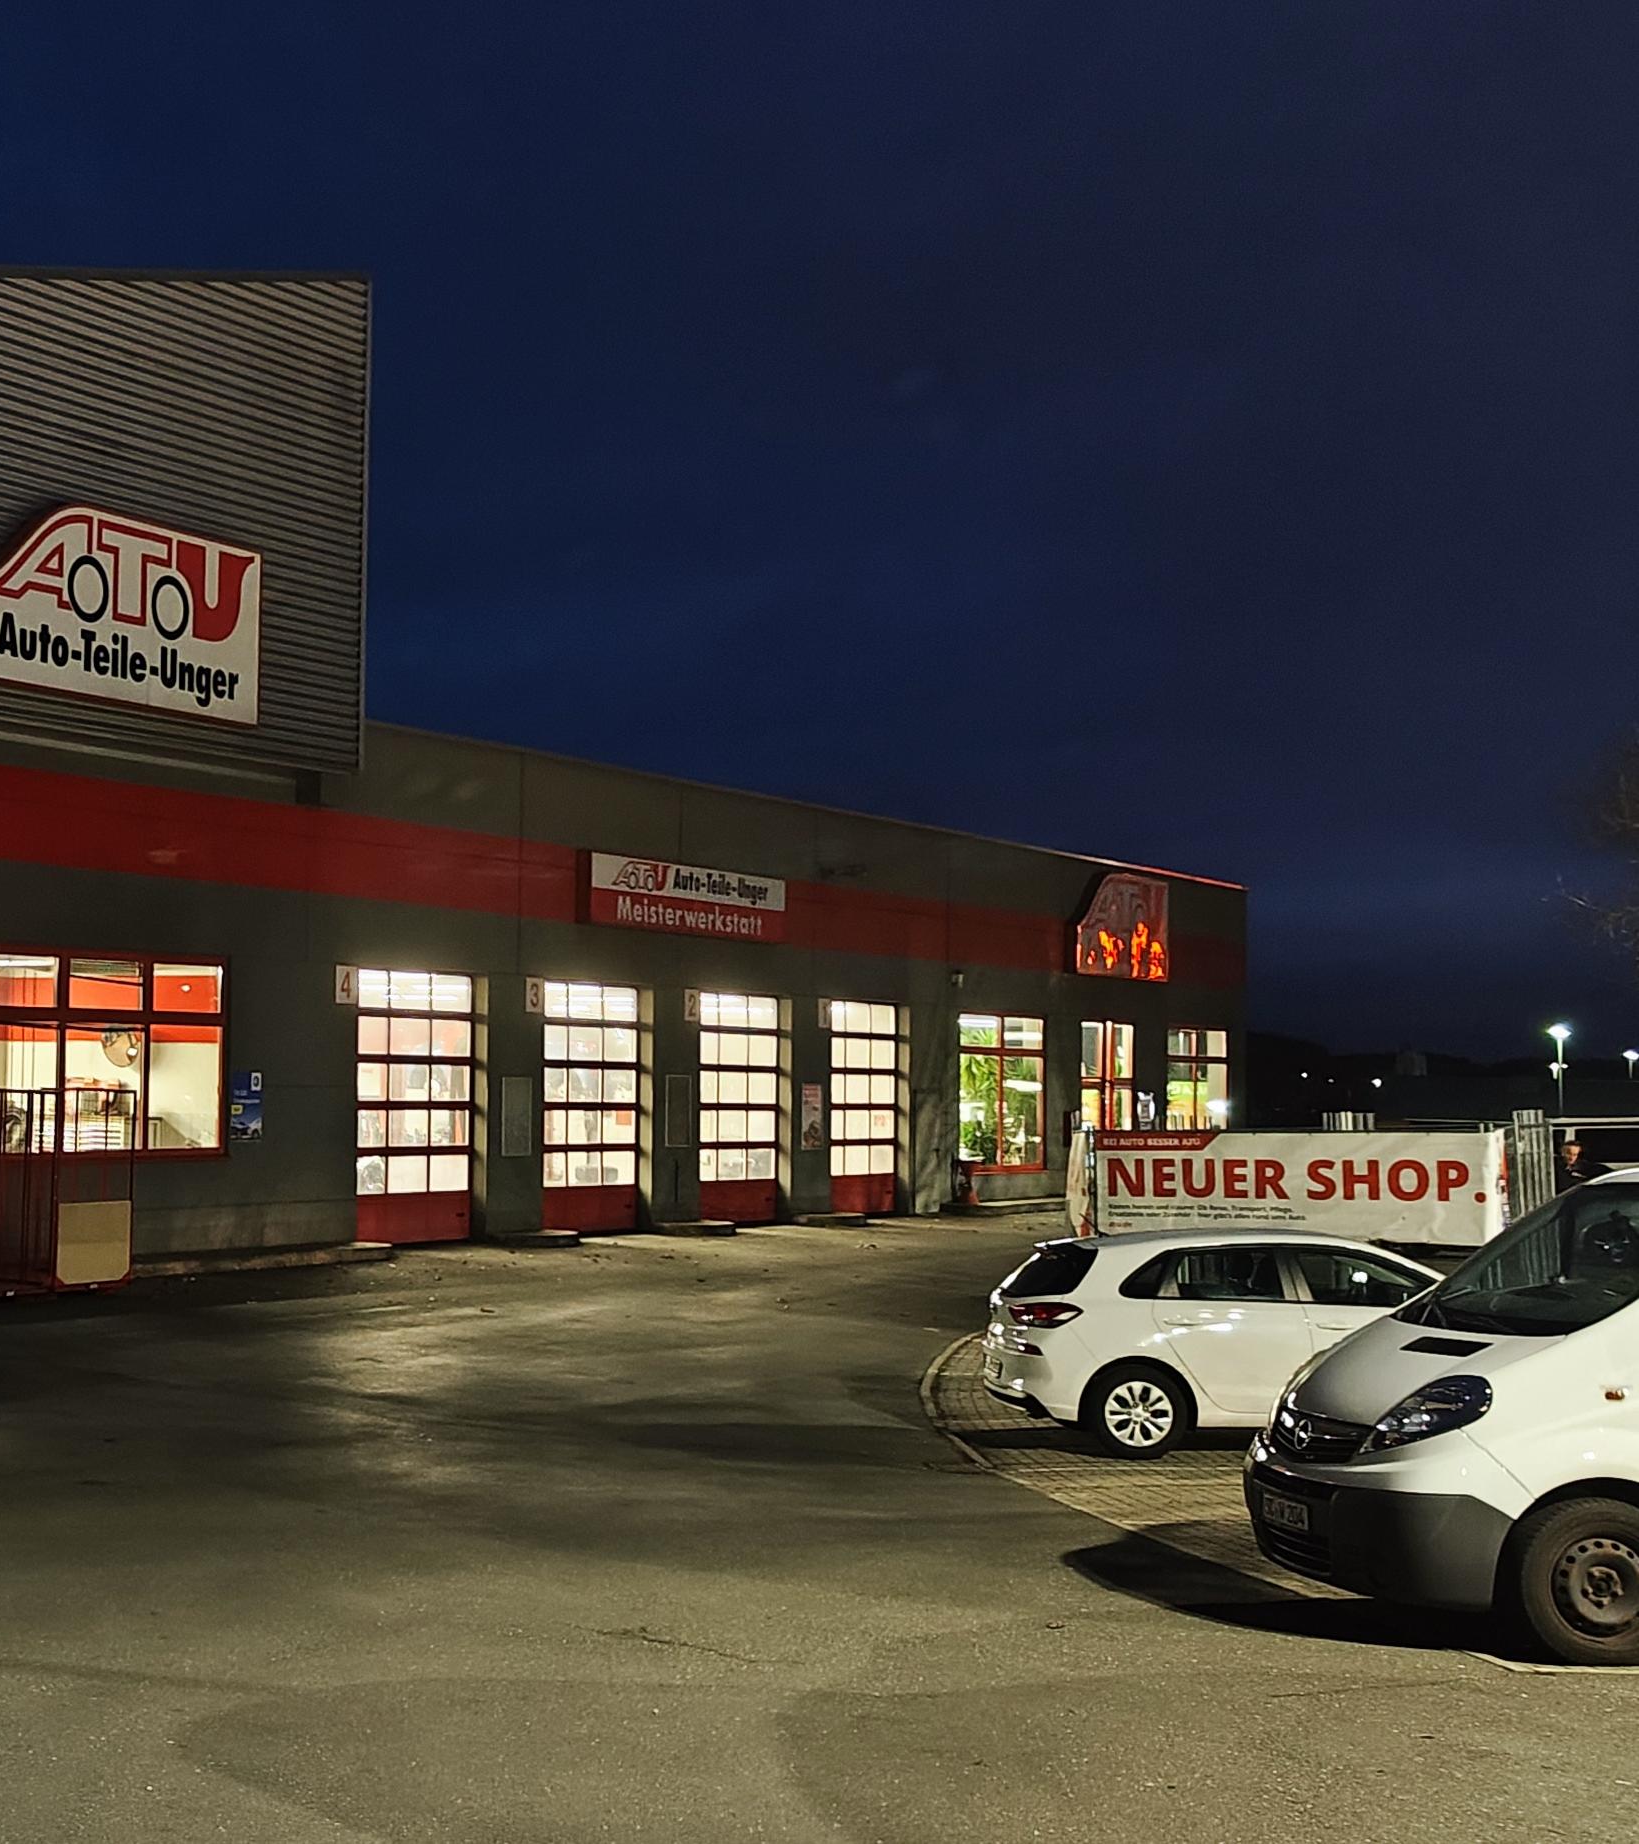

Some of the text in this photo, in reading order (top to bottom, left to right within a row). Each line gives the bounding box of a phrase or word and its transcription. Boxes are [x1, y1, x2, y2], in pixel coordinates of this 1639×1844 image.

[673, 868, 768, 906] Auto-Teile-Unger
[616, 895, 762, 935] Meisterwerkstatt
[341, 971, 350, 998] 4
[529, 983, 539, 1007] 3
[688, 993, 697, 1017] 2
[1119, 1138, 1144, 1146] AUTO
[1107, 1158, 1487, 1204] NEUER SHOP.
